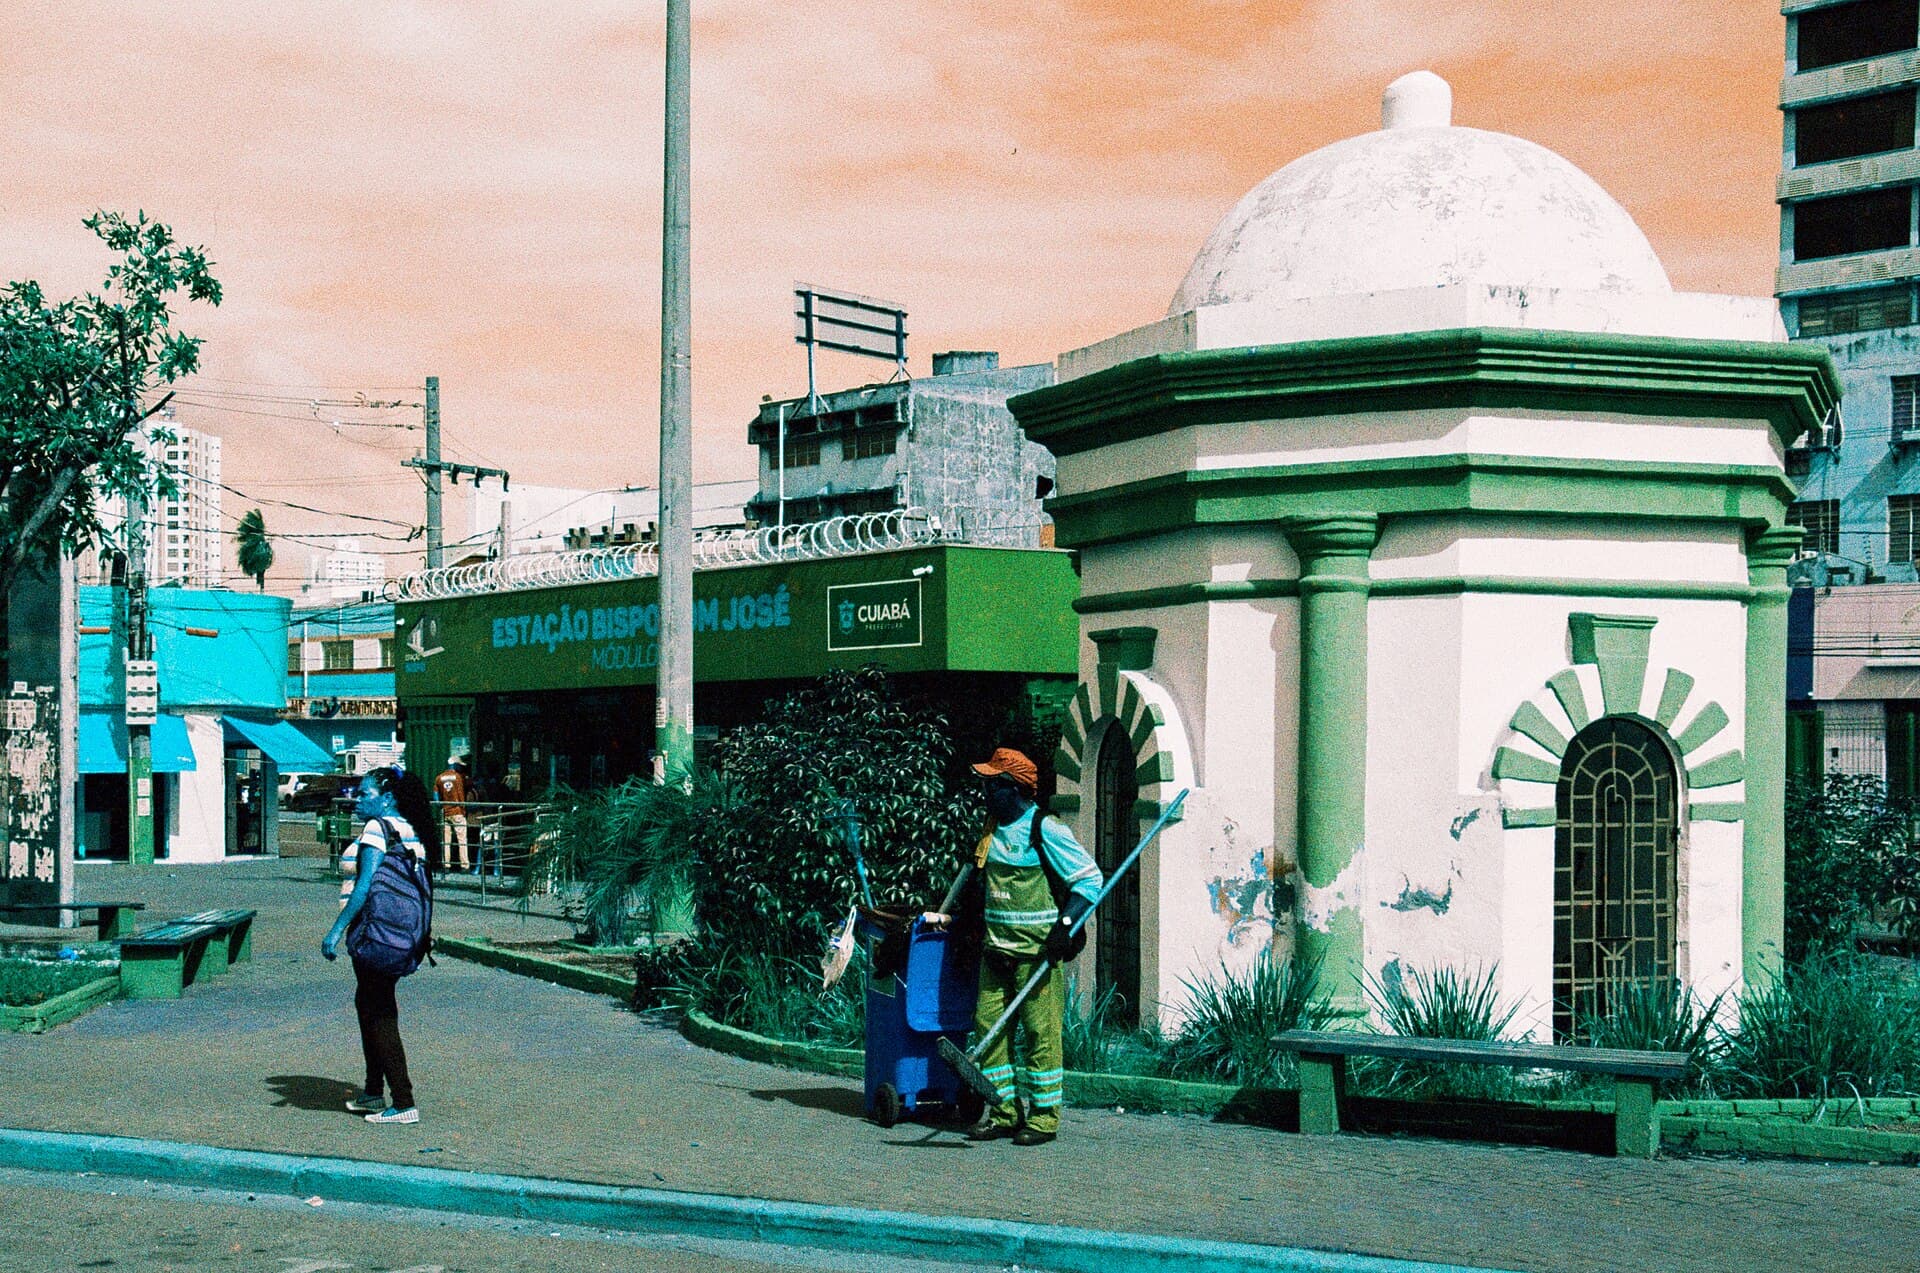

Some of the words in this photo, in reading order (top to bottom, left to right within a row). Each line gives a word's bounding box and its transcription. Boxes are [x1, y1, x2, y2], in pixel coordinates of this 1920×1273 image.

[492, 603, 589, 654] ESTAÇÃO
[591, 603, 660, 640] BISPO
[722, 583, 791, 631] JOSÉ
[857, 598, 911, 622] CUIABÁ
[592, 642, 660, 671] MÓDULO
